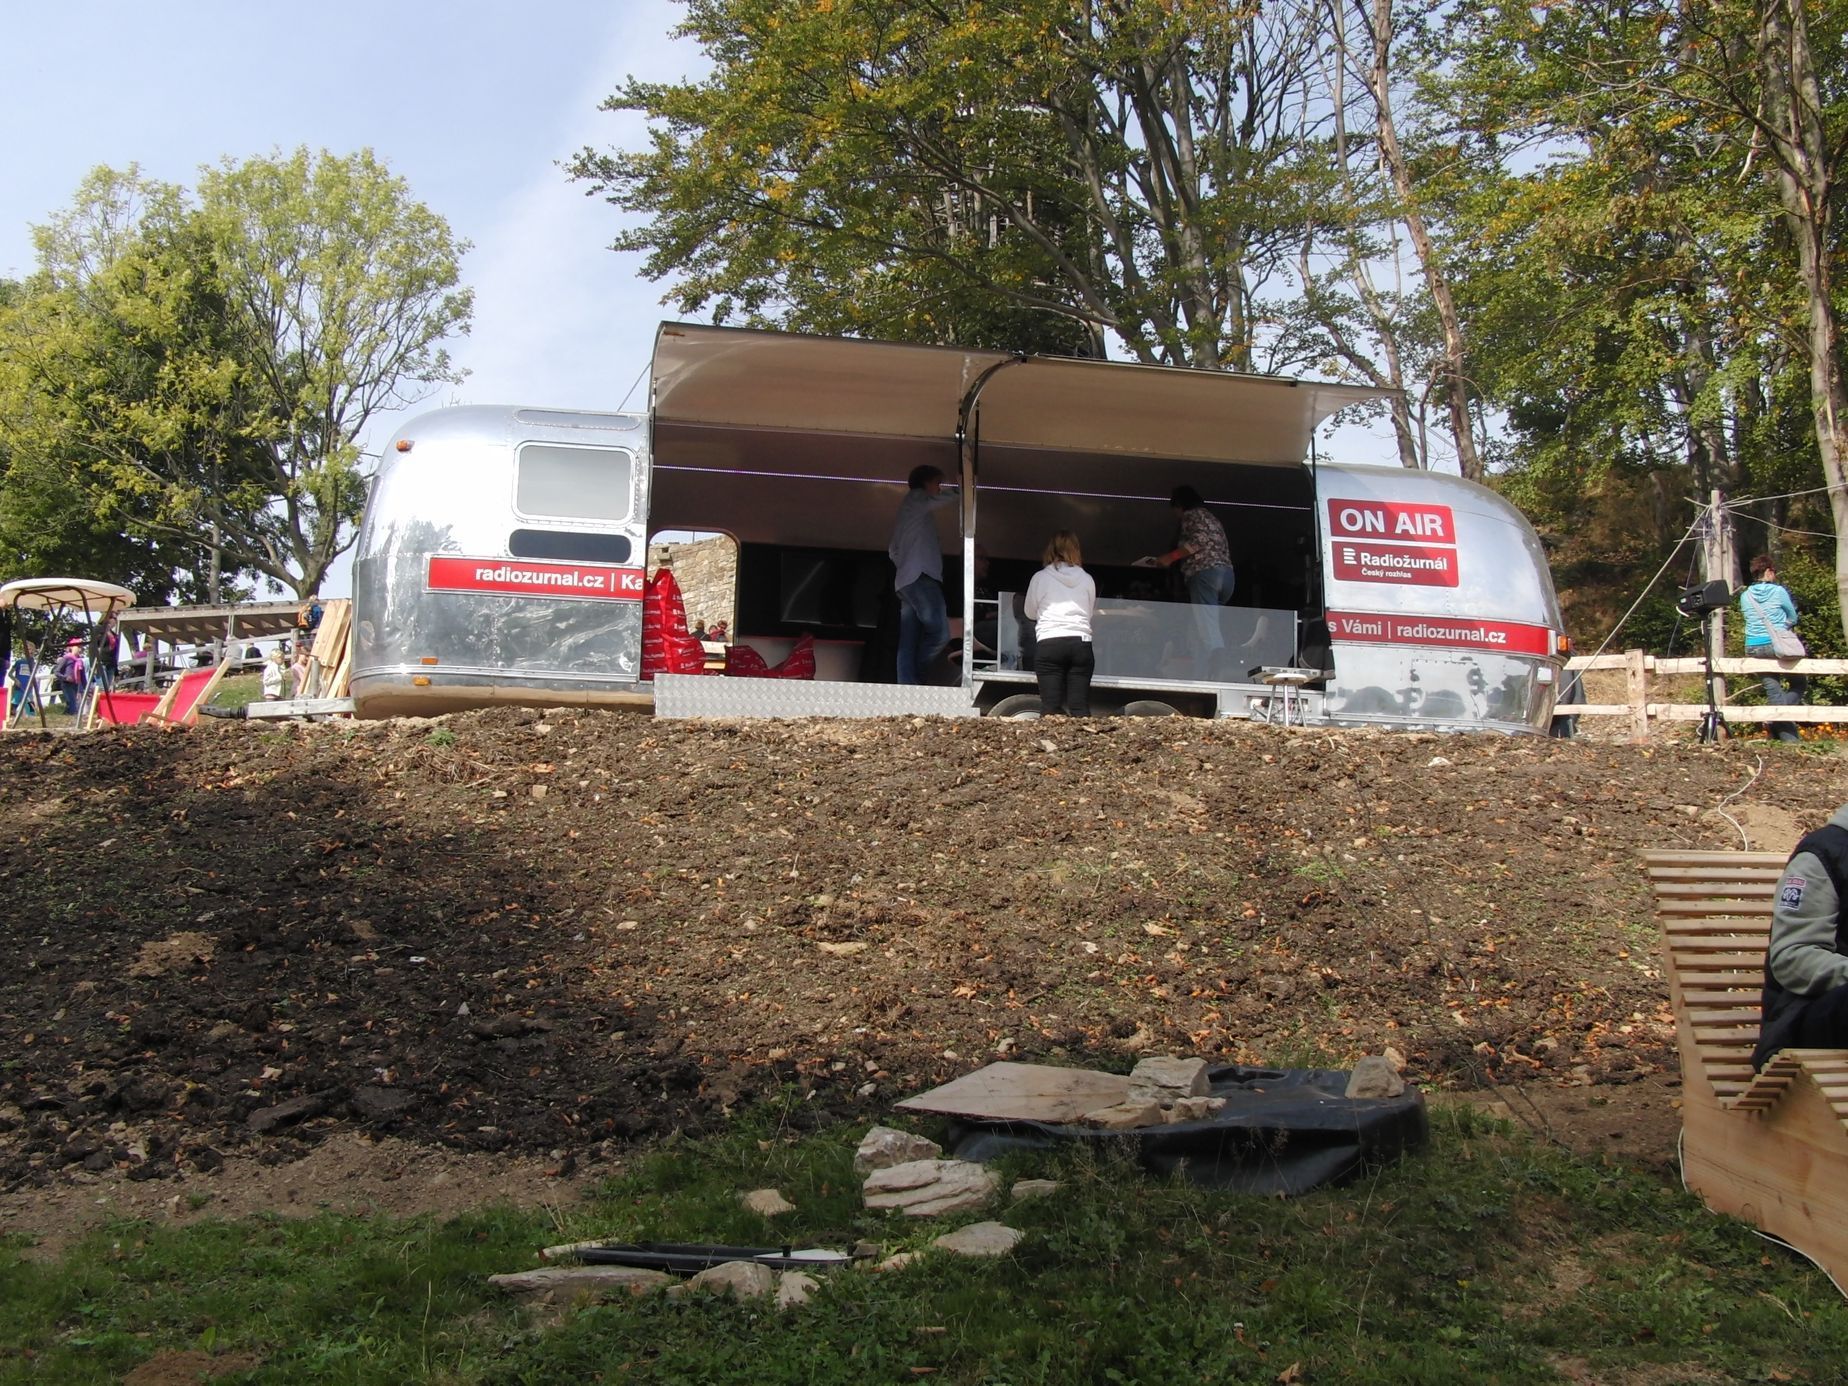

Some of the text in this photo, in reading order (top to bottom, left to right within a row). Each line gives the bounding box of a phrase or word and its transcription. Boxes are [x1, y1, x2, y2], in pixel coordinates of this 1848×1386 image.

[1340, 508, 1444, 537] ON AIR
[1360, 552, 1448, 571] Radiožurnál
[475, 566, 604, 588] radiozurnal.cz
[1341, 618, 1382, 636] Vámi
[1396, 624, 1506, 644] radiozurnal.cz
